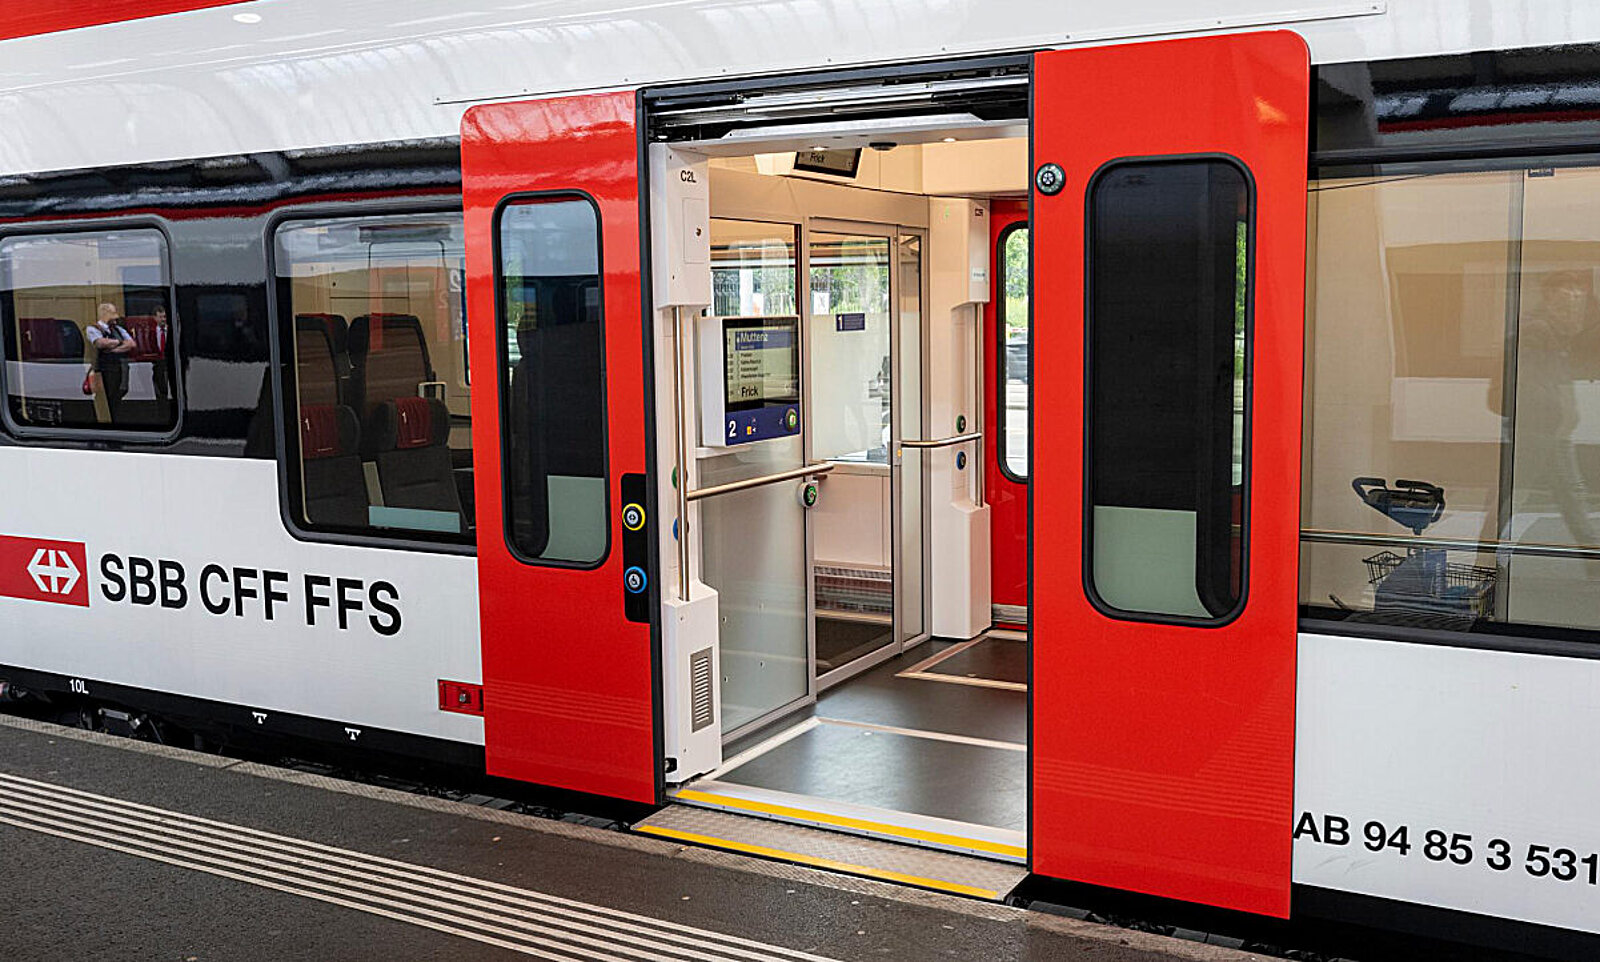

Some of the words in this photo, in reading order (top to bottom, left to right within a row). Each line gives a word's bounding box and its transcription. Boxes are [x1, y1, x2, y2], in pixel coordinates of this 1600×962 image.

[809, 152, 825, 163] Frick
[680, 169, 697, 183] C2L
[838, 315, 843, 330] 1
[740, 331, 769, 343] Muttenz
[741, 385, 759, 397] Frick
[402, 411, 408, 424] 1
[304, 418, 311, 432] 1
[729, 420, 737, 437] 2
[100, 553, 188, 610] SBB
[200, 563, 289, 621] CFF
[304, 573, 402, 636] FFS
[69, 679, 89, 695] 10L
[1293, 811, 1350, 846] AB
[1363, 820, 1412, 856] 94
[1423, 829, 1473, 865] 85
[1486, 838, 1512, 871] 3
[1524, 844, 1598, 886] 531
